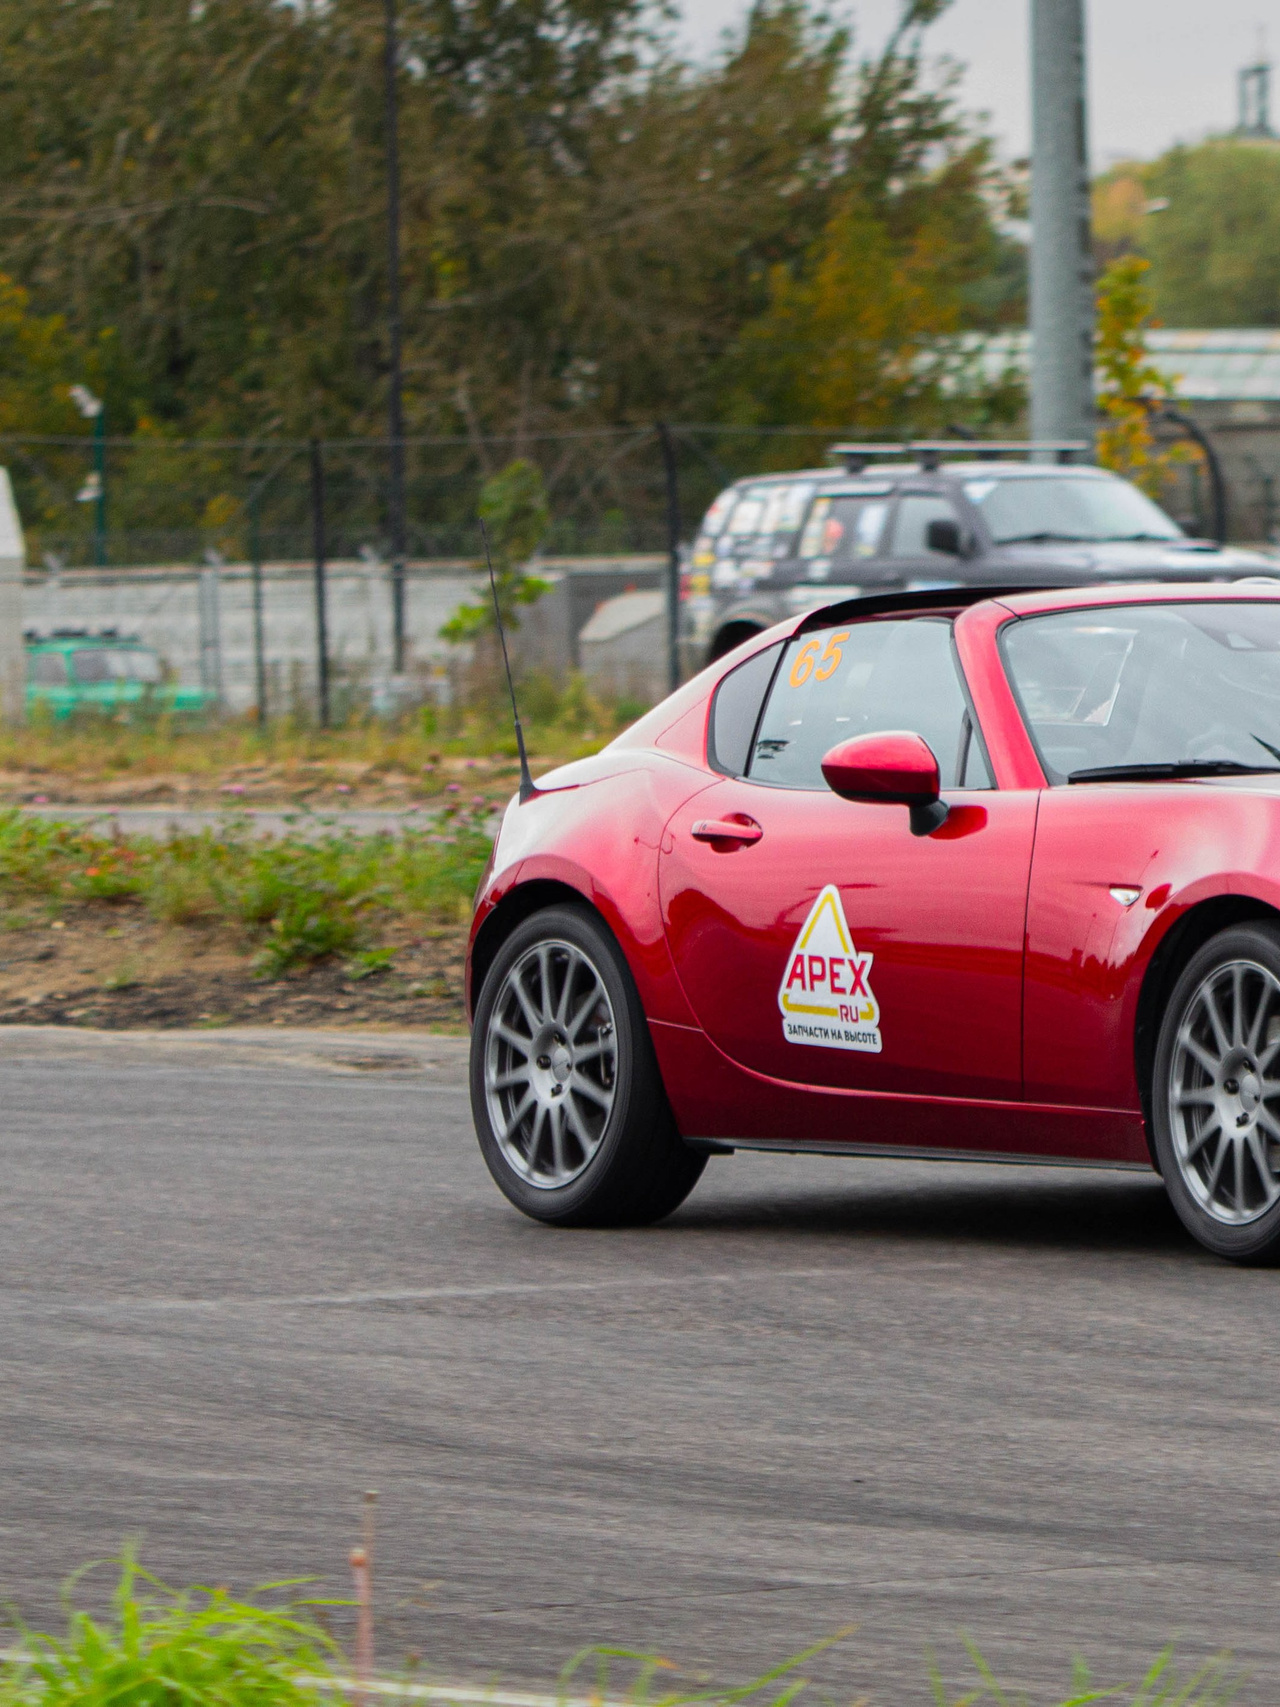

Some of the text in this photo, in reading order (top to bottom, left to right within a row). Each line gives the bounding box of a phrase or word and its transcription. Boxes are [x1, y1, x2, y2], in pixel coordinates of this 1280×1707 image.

[788, 631, 851, 688] 65
[785, 954, 869, 998] APEX
[839, 1004, 860, 1024] RU
[787, 1024, 878, 1045] ЗАПЧАСТИ НА ВЫСОТЕ
